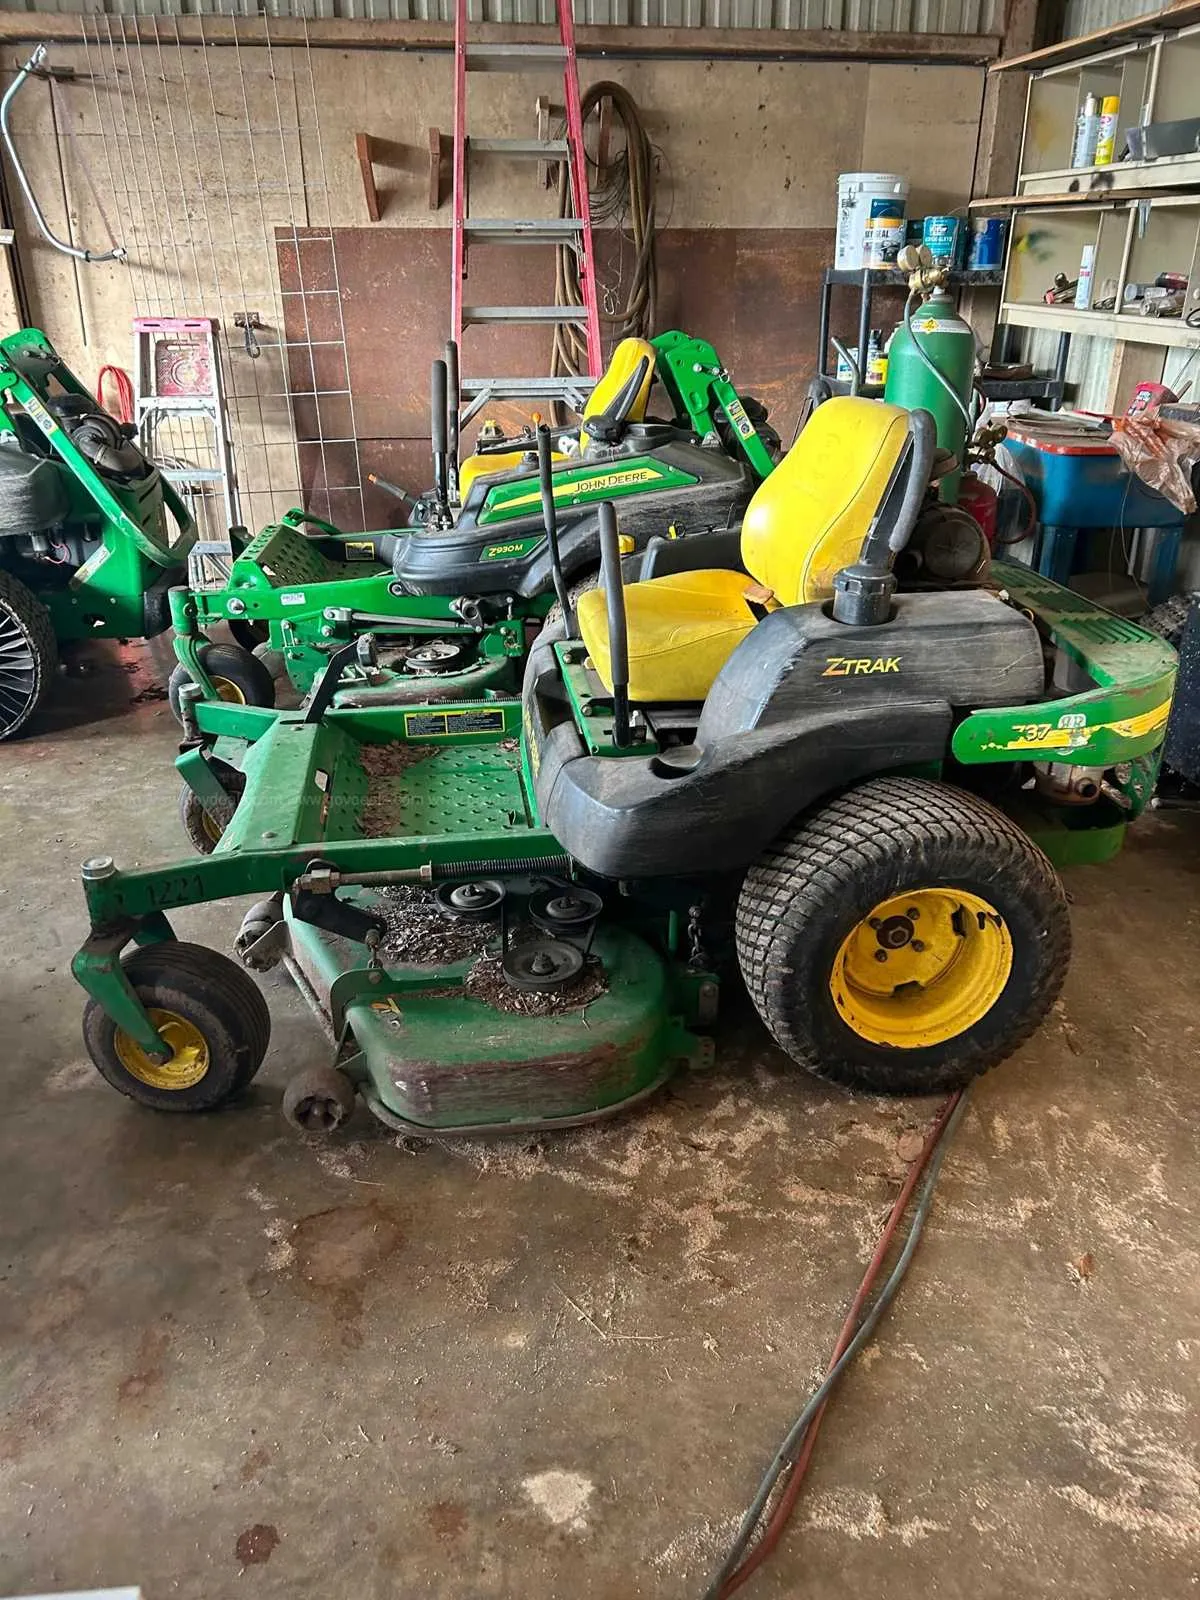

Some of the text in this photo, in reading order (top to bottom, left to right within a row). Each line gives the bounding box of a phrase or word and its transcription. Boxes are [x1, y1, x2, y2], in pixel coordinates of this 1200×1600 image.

[575, 471, 648, 493] JOHN DEERE
[488, 543, 524, 557] Z930M
[821, 656, 903, 677] ZTRAK
